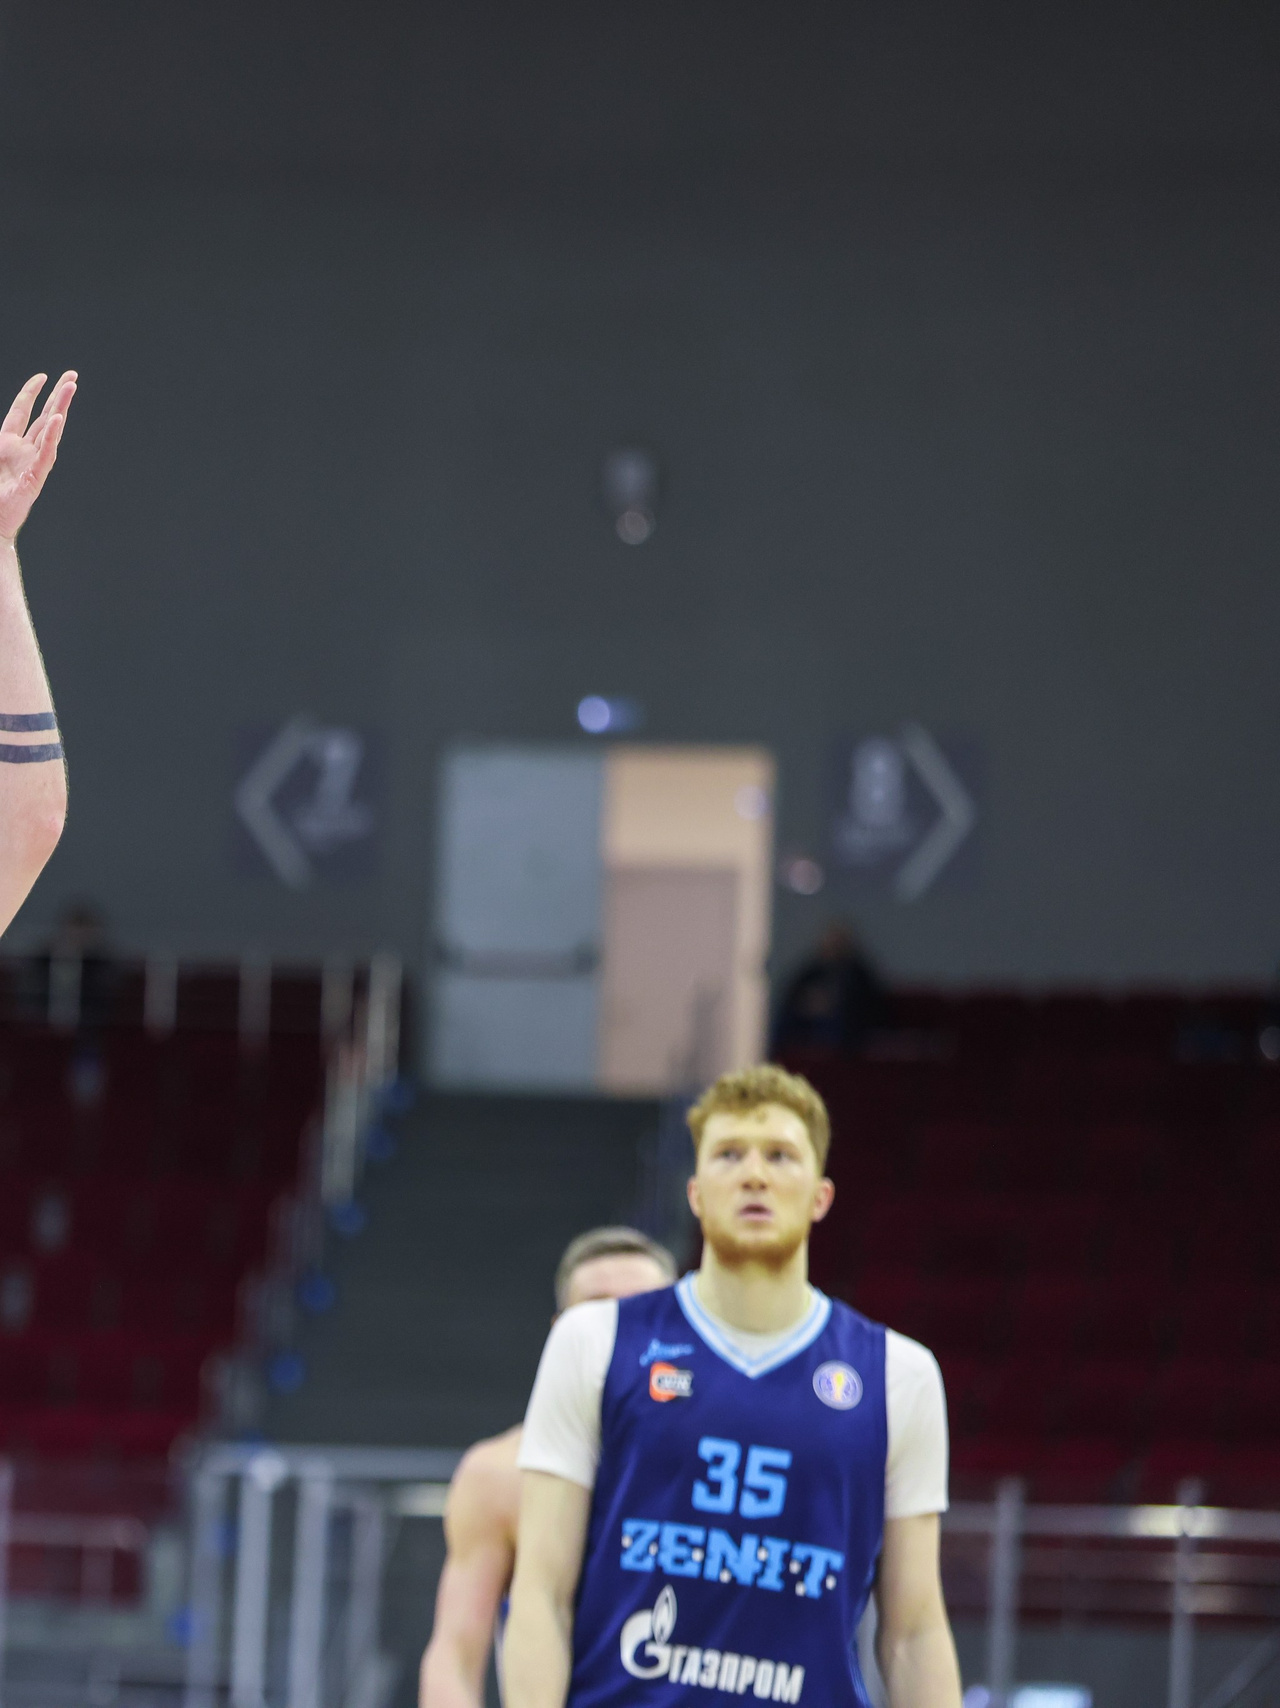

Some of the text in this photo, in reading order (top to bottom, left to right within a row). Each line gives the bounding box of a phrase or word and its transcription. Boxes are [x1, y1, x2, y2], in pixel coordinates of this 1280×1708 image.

[691, 1436, 793, 1519] 35
[620, 1518, 846, 1600] ZENIT
[669, 1644, 806, 1706] ГАЗПРОМ
